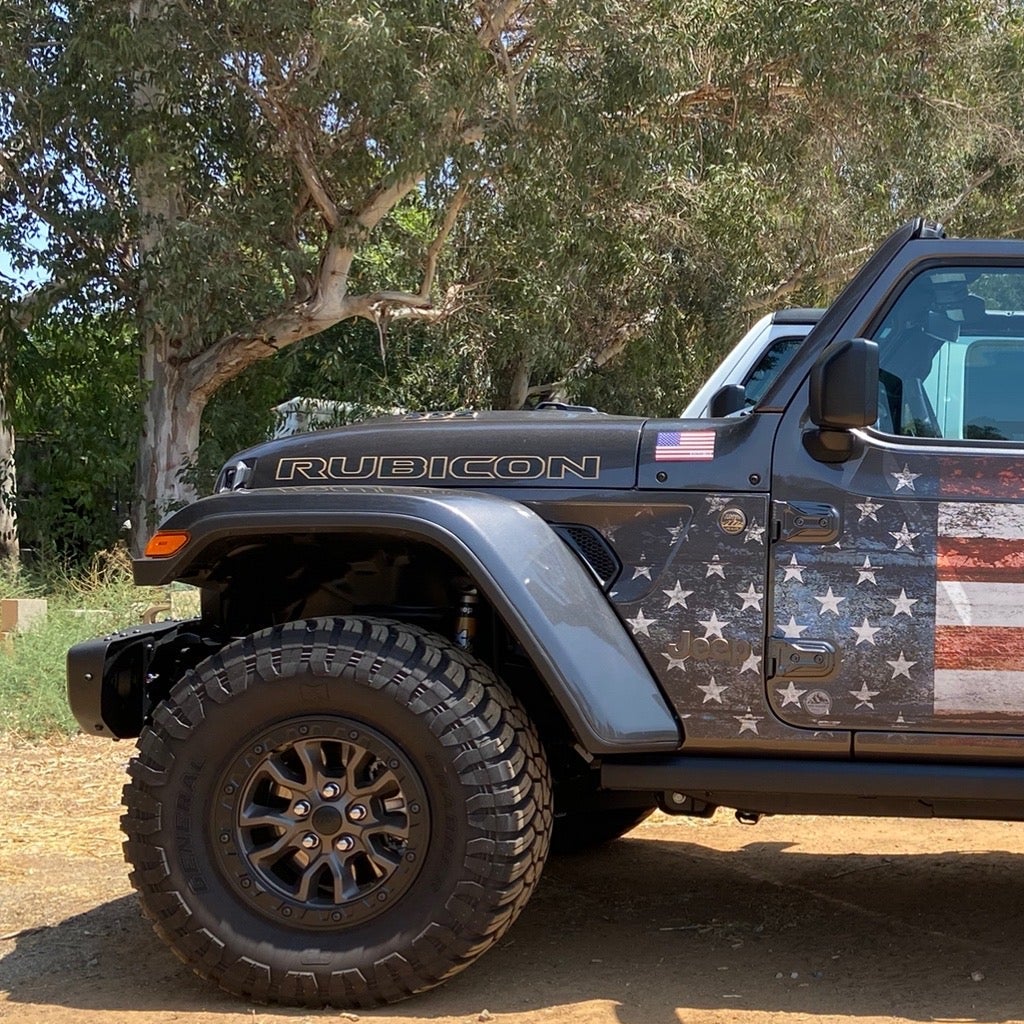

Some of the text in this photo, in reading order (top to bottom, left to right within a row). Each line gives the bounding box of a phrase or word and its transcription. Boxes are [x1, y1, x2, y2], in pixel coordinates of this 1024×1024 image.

[274, 455, 601, 481] RUBICON
[668, 629, 752, 666] Jeep
[175, 757, 208, 895] GENERAL
